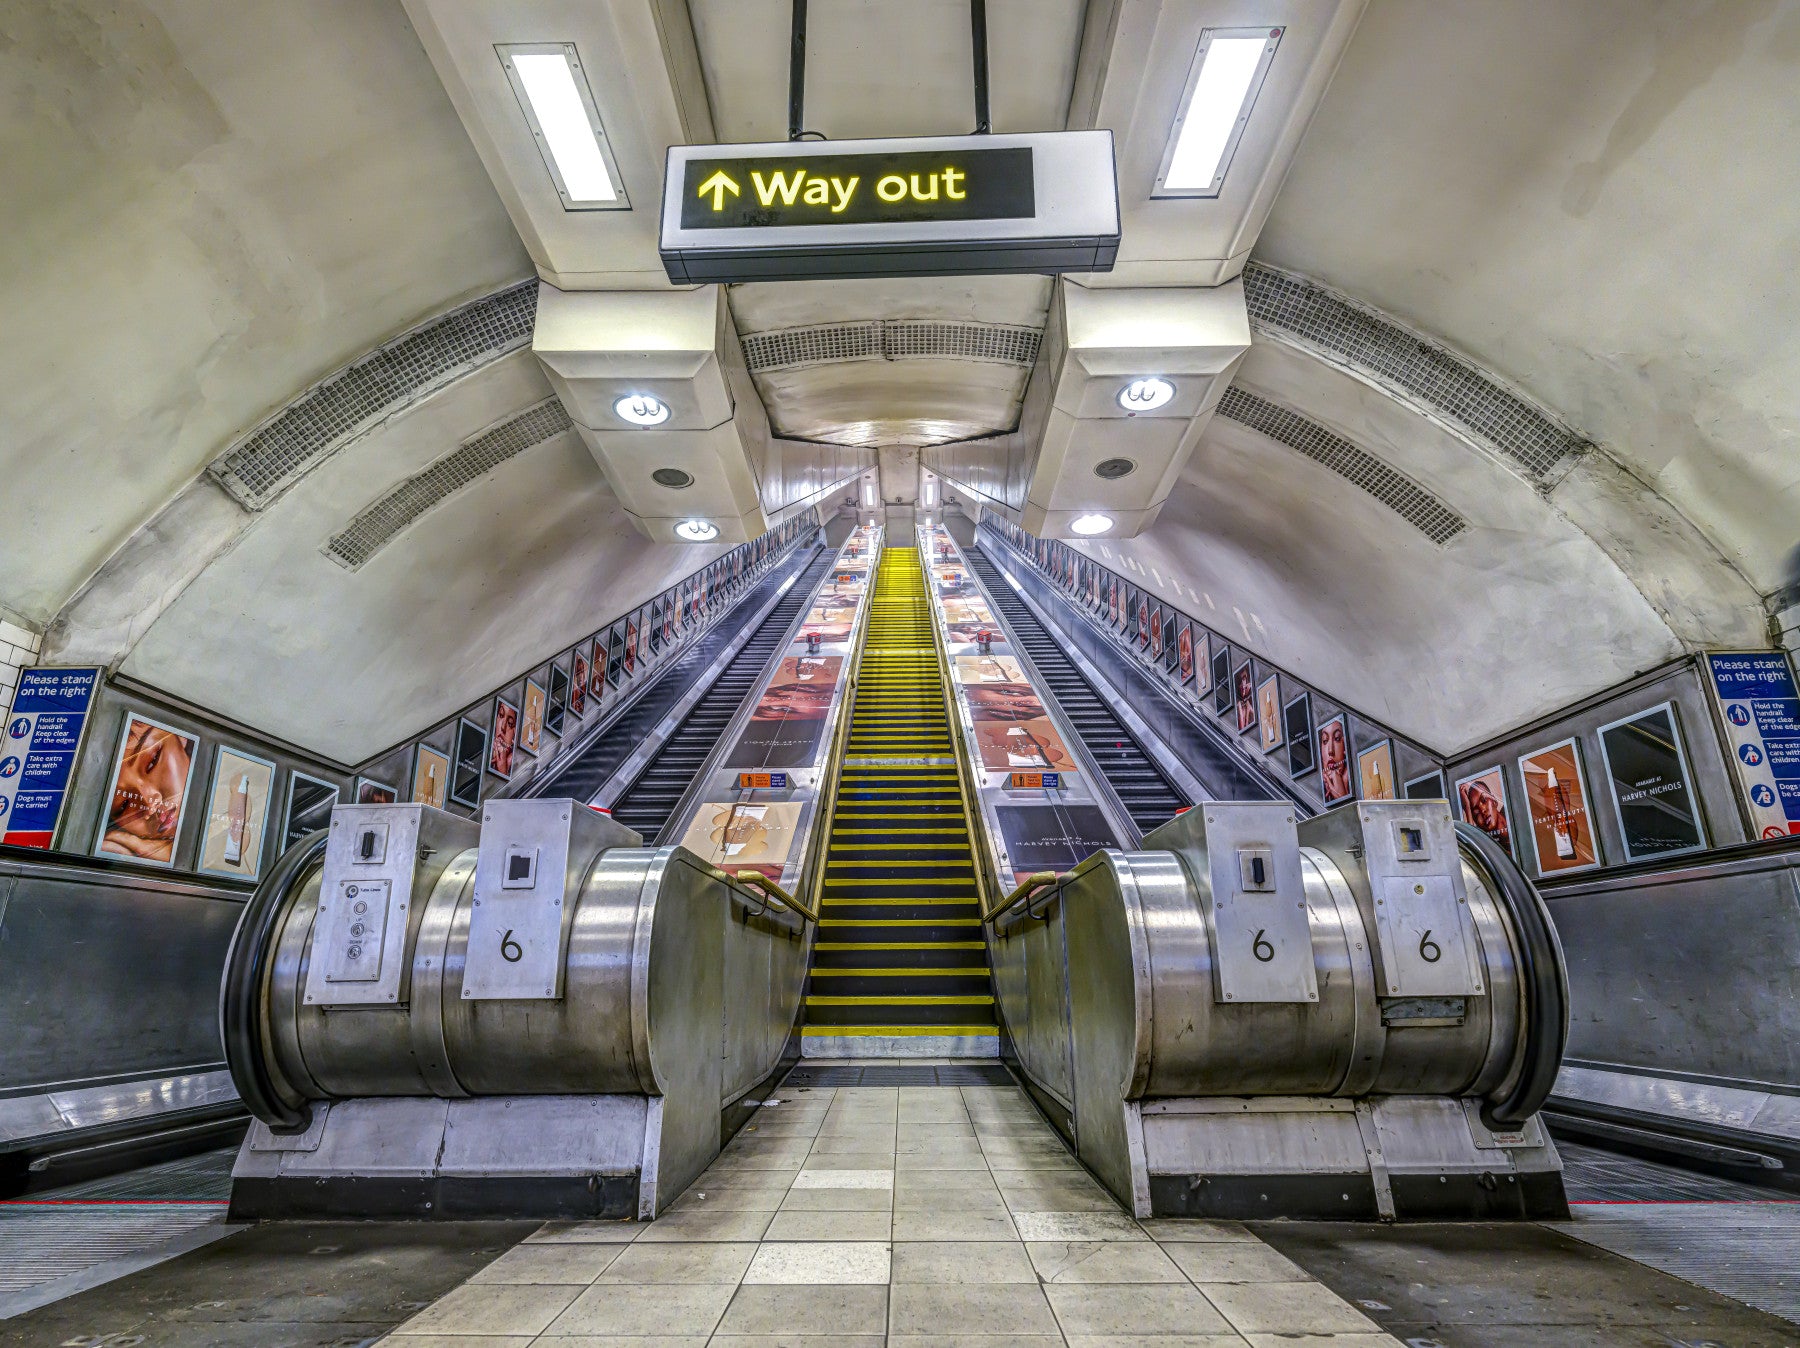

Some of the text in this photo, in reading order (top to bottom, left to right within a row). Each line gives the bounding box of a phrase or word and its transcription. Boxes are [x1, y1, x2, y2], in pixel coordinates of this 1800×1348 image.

[752, 166, 967, 212] Way out
[1712, 660, 1786, 669] Please stand
[23, 674, 94, 685] Please stand
[1717, 671, 1787, 683] on the right
[20, 686, 87, 698] on the right
[55, 737, 76, 745] edges
[1621, 781, 1683, 803] HARVEY NICHOLS
[1779, 783, 1799, 792] Dogs
[17, 795, 34, 803] Dogs
[116, 789, 179, 810] FENTY BEAUTY
[1781, 790, 1792, 798] be
[1556, 807, 1585, 819] BEAUTY
[500, 929, 523, 963] 6
[1253, 929, 1274, 963] 6
[1420, 929, 1441, 963] 6
